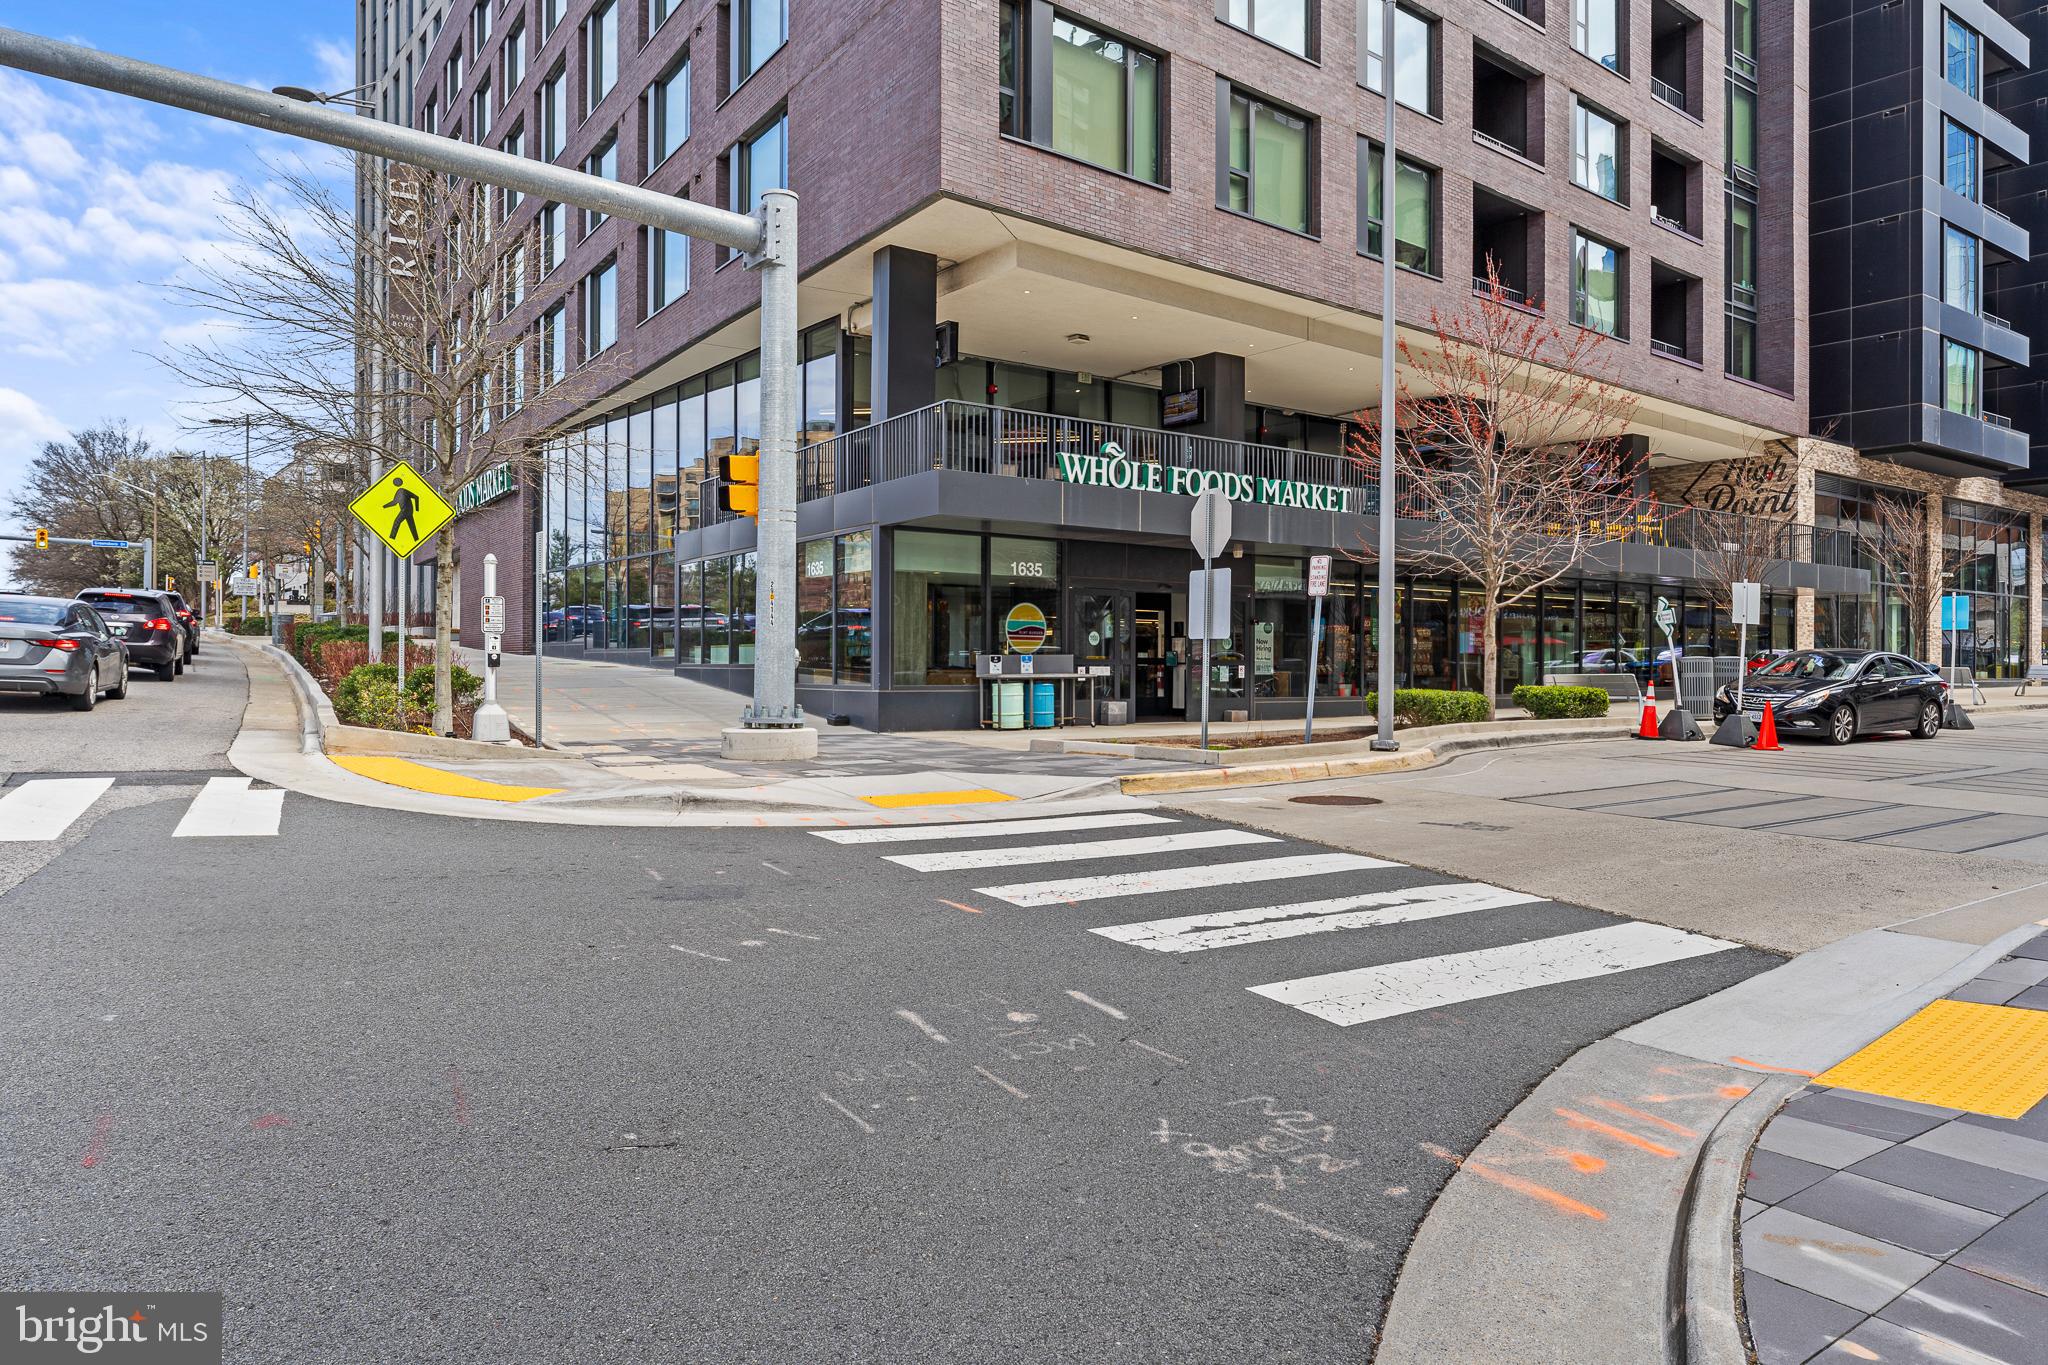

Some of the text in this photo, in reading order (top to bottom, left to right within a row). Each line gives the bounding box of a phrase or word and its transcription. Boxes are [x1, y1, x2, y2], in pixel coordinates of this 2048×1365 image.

[388, 179, 420, 280] RISE
[476, 461, 509, 507] MARKET
[1057, 443, 1163, 493] WHOLE
[1167, 465, 1254, 503] FOODS
[1257, 476, 1352, 513] MARKET
[1722, 454, 1787, 491] High
[1704, 483, 1799, 515] Point
[807, 560, 824, 576] 1635
[1010, 561, 1043, 577] 1635
[1256, 645, 1271, 653] Hiring
